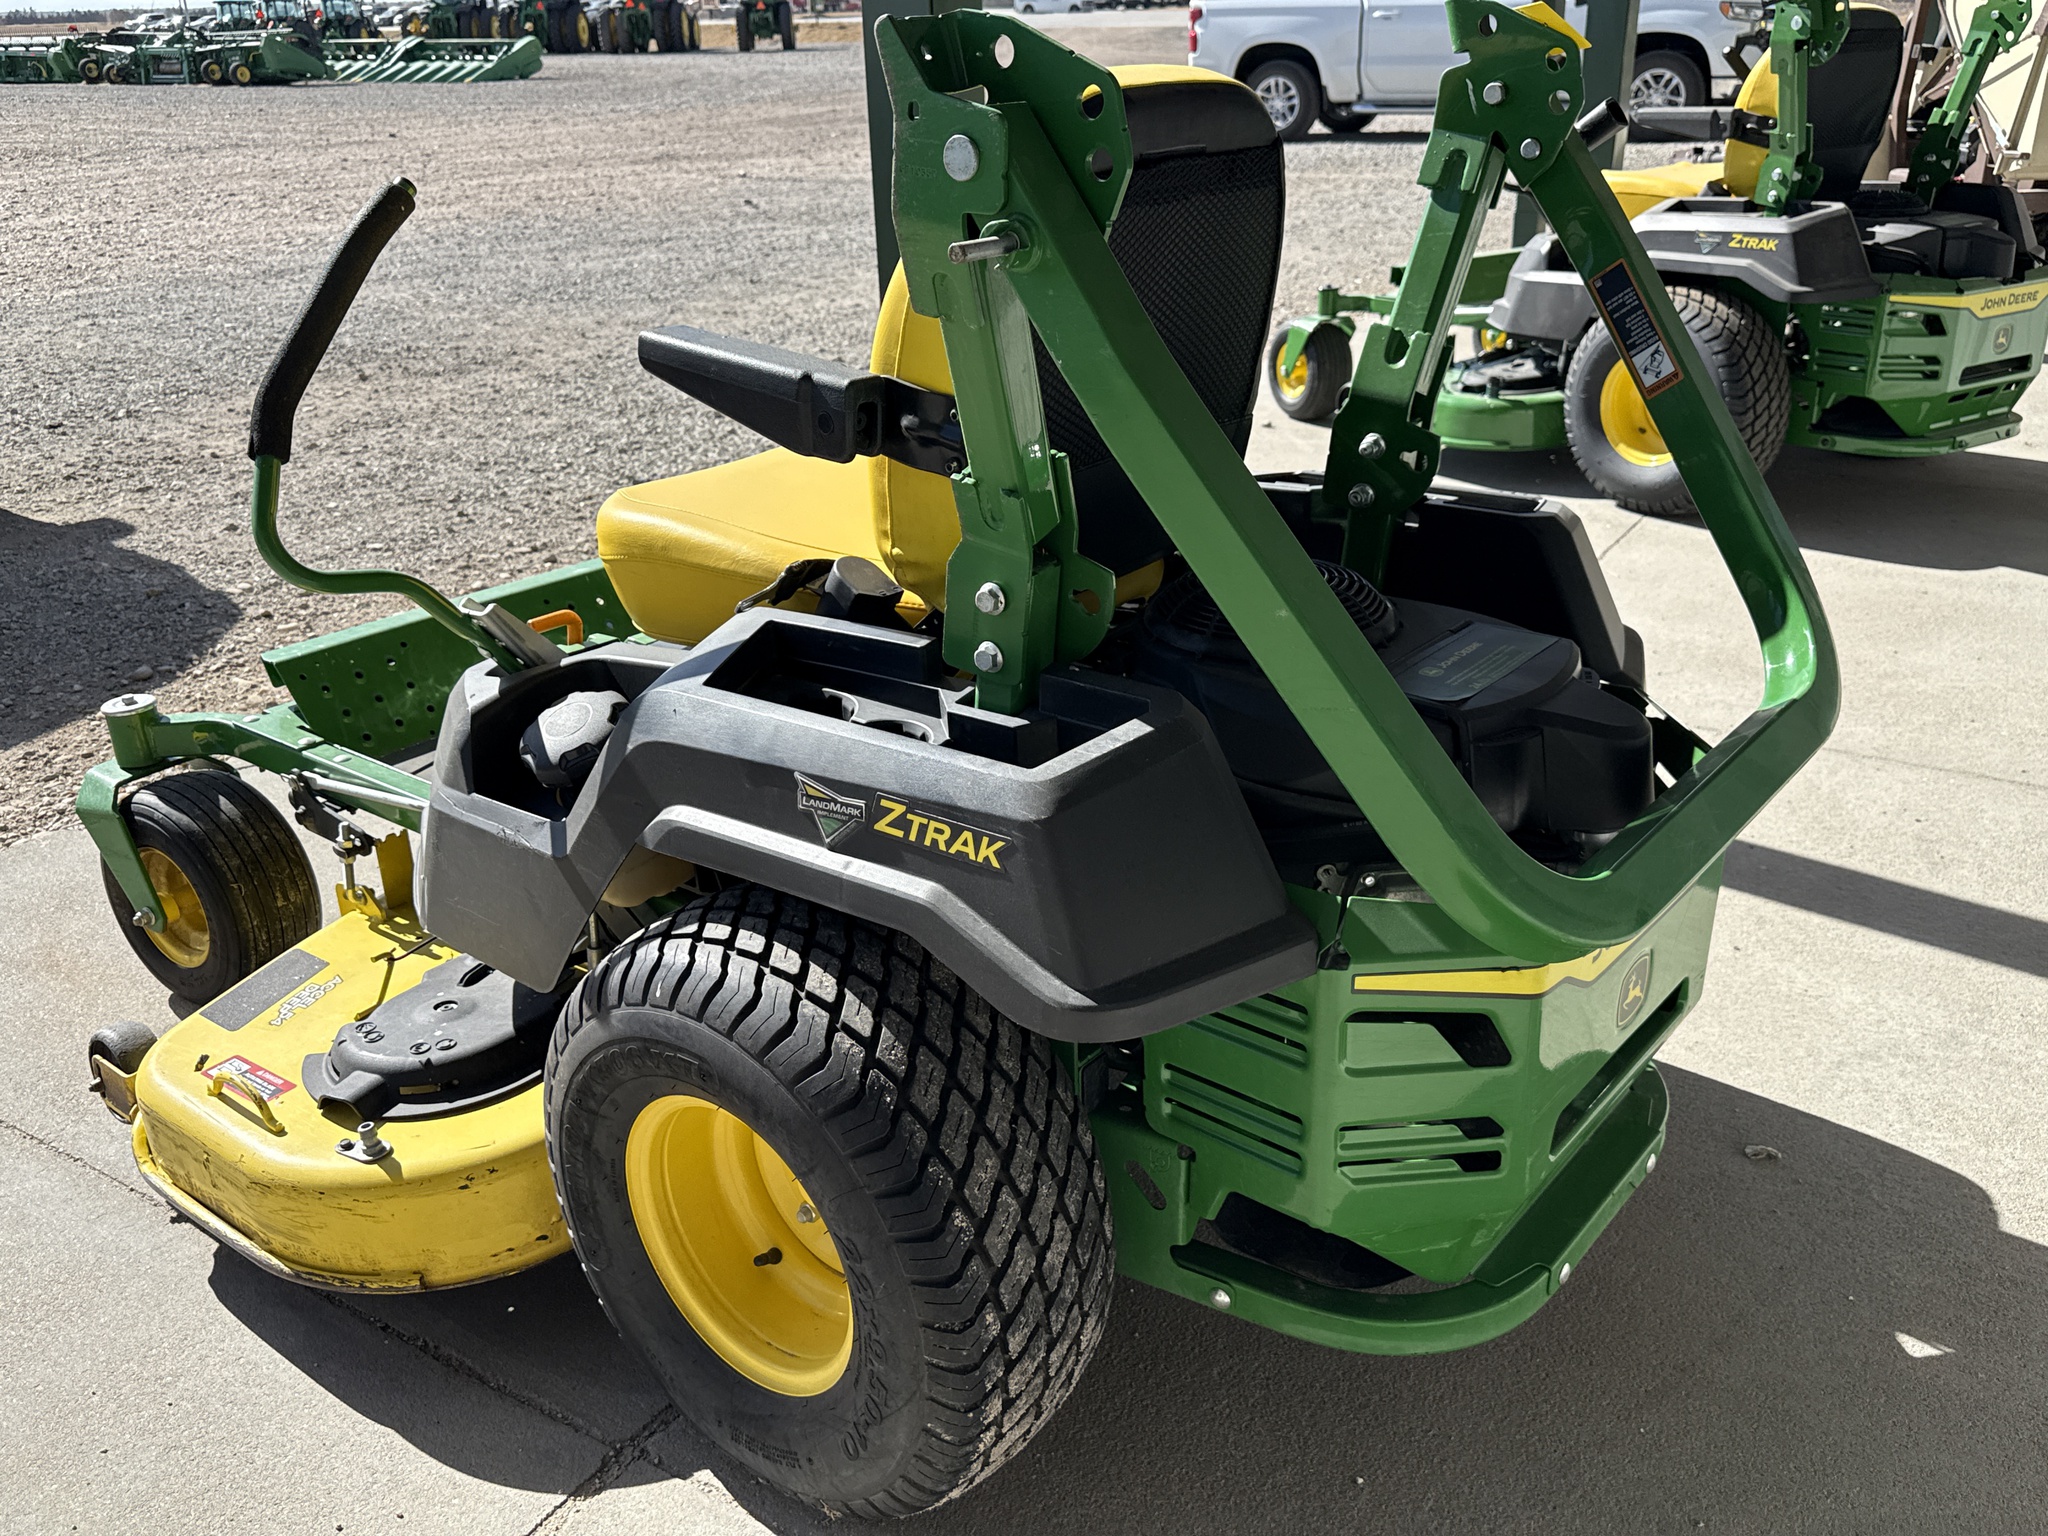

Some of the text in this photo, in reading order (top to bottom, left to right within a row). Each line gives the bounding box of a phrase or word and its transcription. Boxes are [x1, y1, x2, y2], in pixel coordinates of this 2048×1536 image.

[1728, 233, 1779, 252] ZTRAK
[1980, 290, 2040, 311] JOHN DEERE
[816, 810, 849, 821] IMPLEMENT
[873, 798, 1006, 870] ZTRAK
[269, 974, 343, 1026] ACCEL 54
[279, 983, 320, 1013] DEEP
